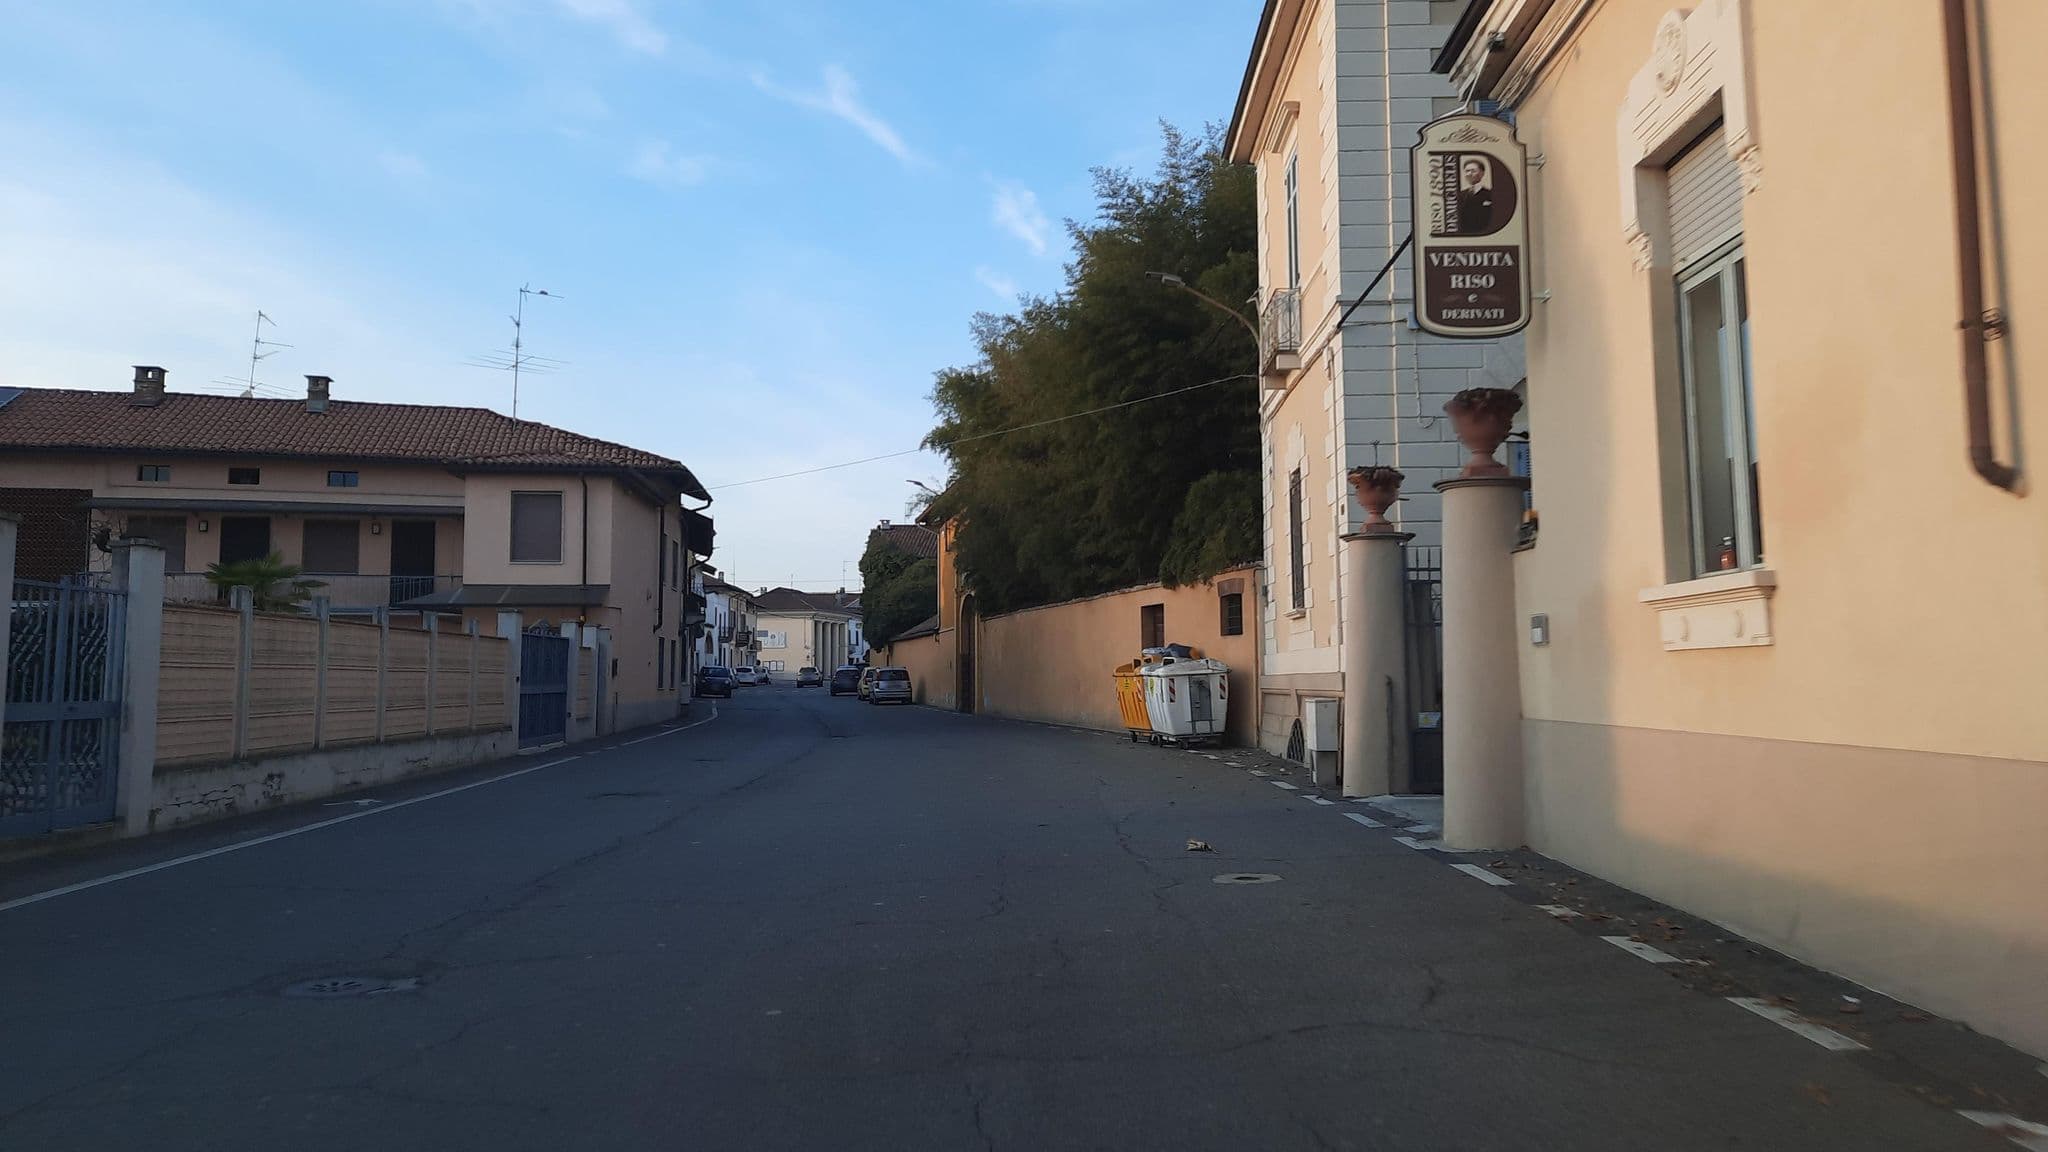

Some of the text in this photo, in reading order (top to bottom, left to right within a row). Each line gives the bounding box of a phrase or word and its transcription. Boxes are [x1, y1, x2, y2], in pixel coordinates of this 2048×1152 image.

[1431, 203, 1443, 233] RISO
[1429, 252, 1514, 267] VENDITA
[1450, 274, 1496, 288] RISO
[1468, 293, 1478, 303] e
[1442, 309, 1505, 320] DERIVATI
